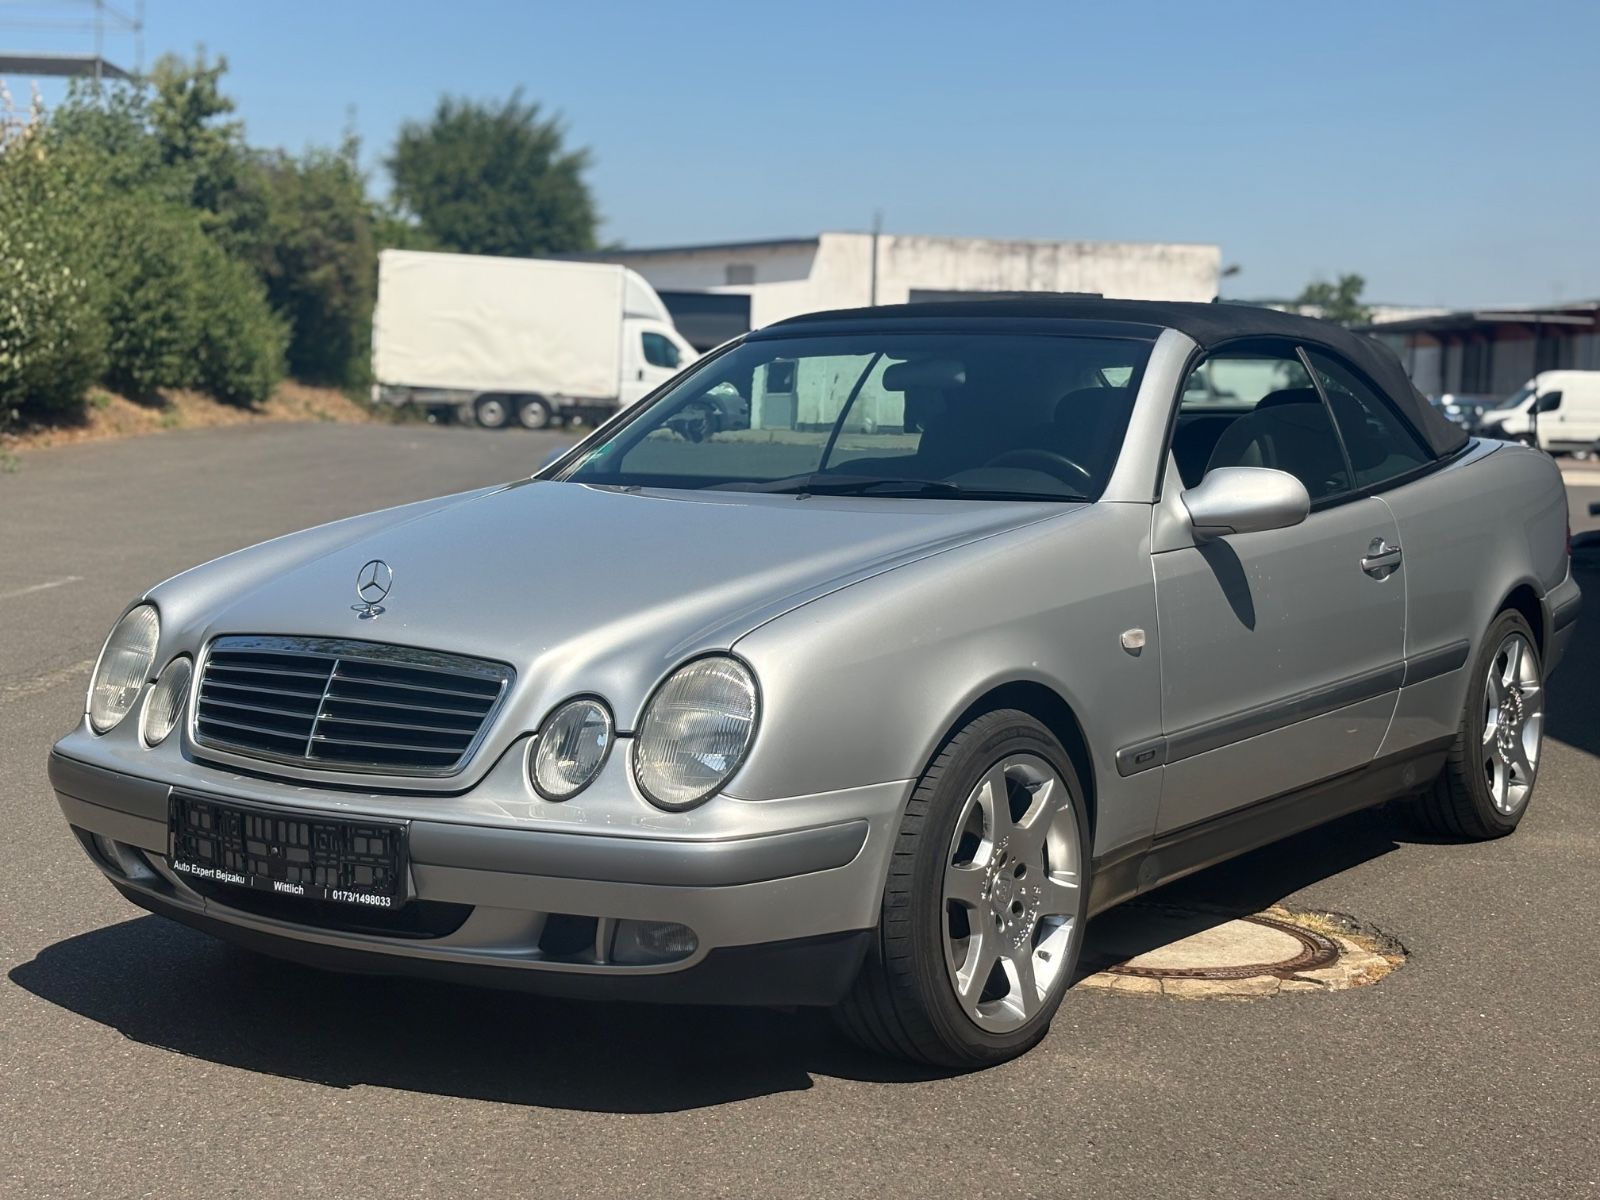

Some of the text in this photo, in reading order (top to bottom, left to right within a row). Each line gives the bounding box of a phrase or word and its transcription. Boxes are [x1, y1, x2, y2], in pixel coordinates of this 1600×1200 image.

[173, 860, 391, 907] Auto Expert Bejzaku Wittlich 0173/1498033
